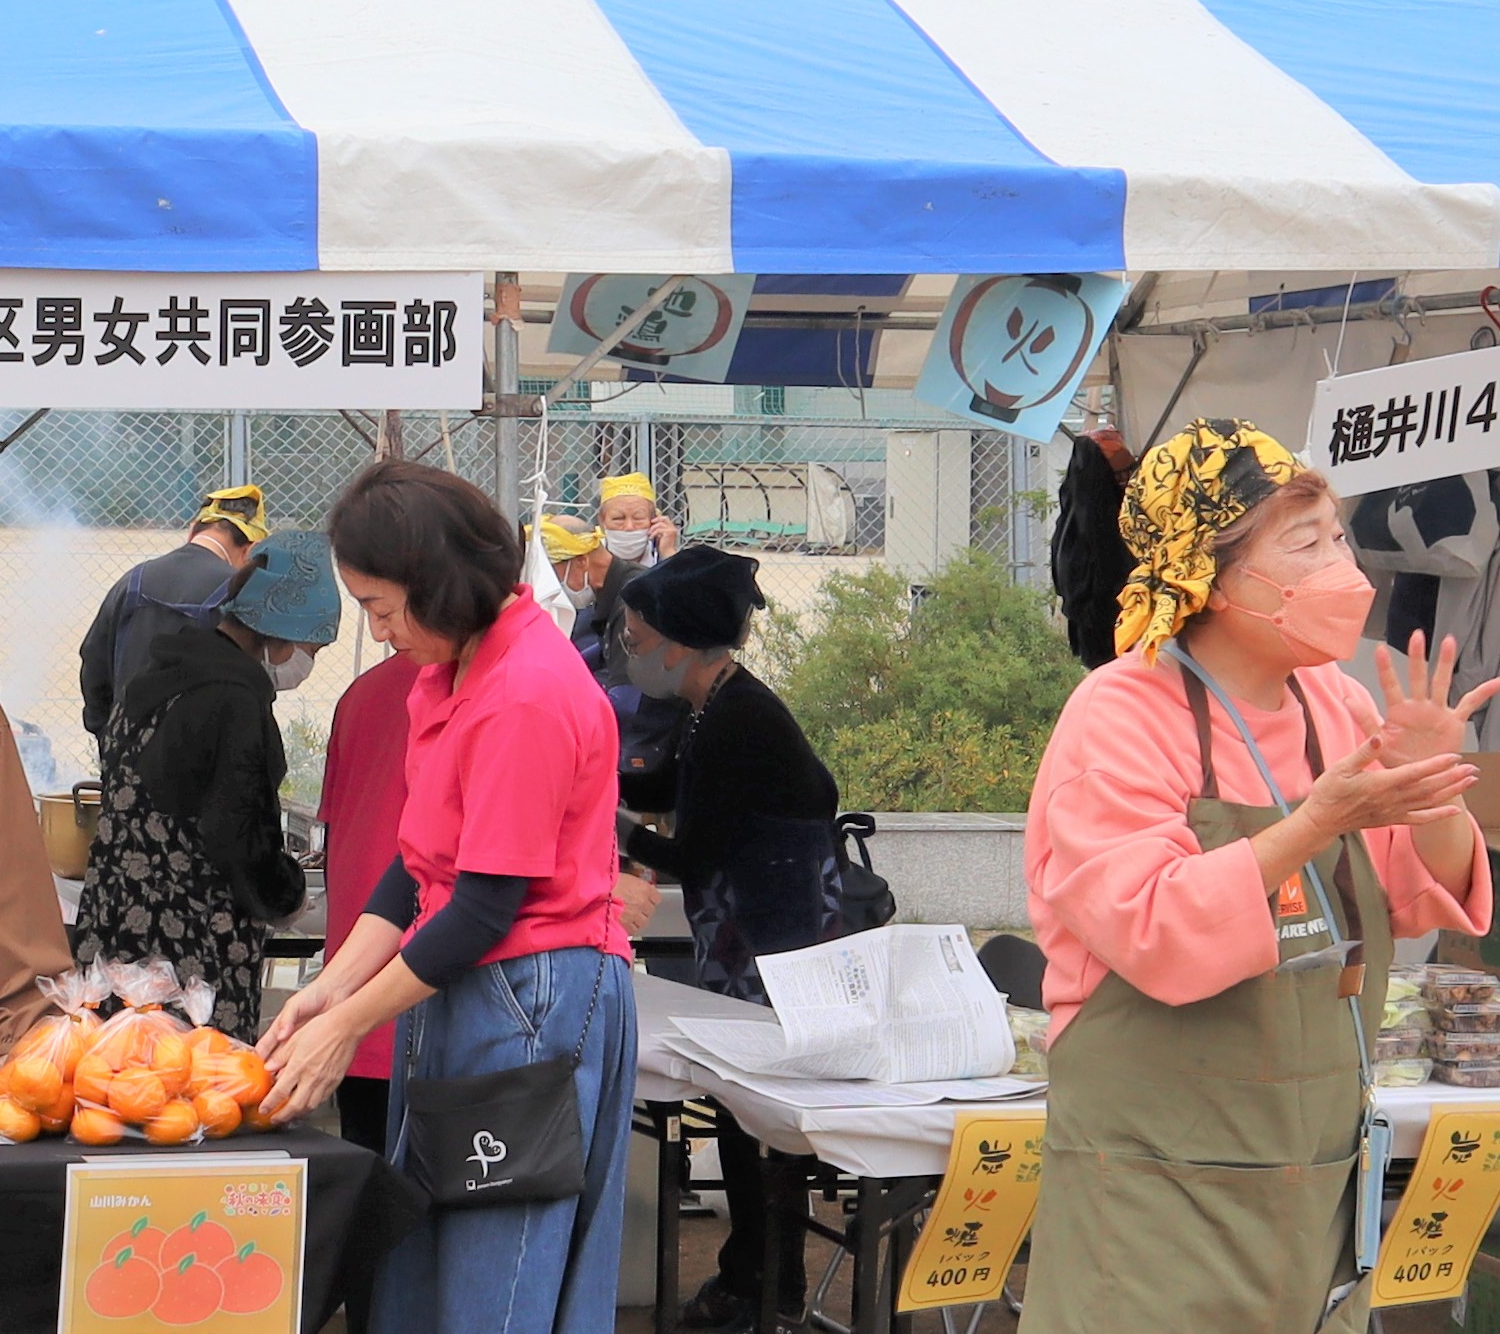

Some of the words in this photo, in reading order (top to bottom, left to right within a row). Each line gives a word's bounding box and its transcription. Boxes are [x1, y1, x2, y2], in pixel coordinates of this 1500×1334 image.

[1281, 922, 1307, 939] ARE
[1307, 917, 1329, 935] NE
[89, 1195, 152, 1208] 山川みかん
